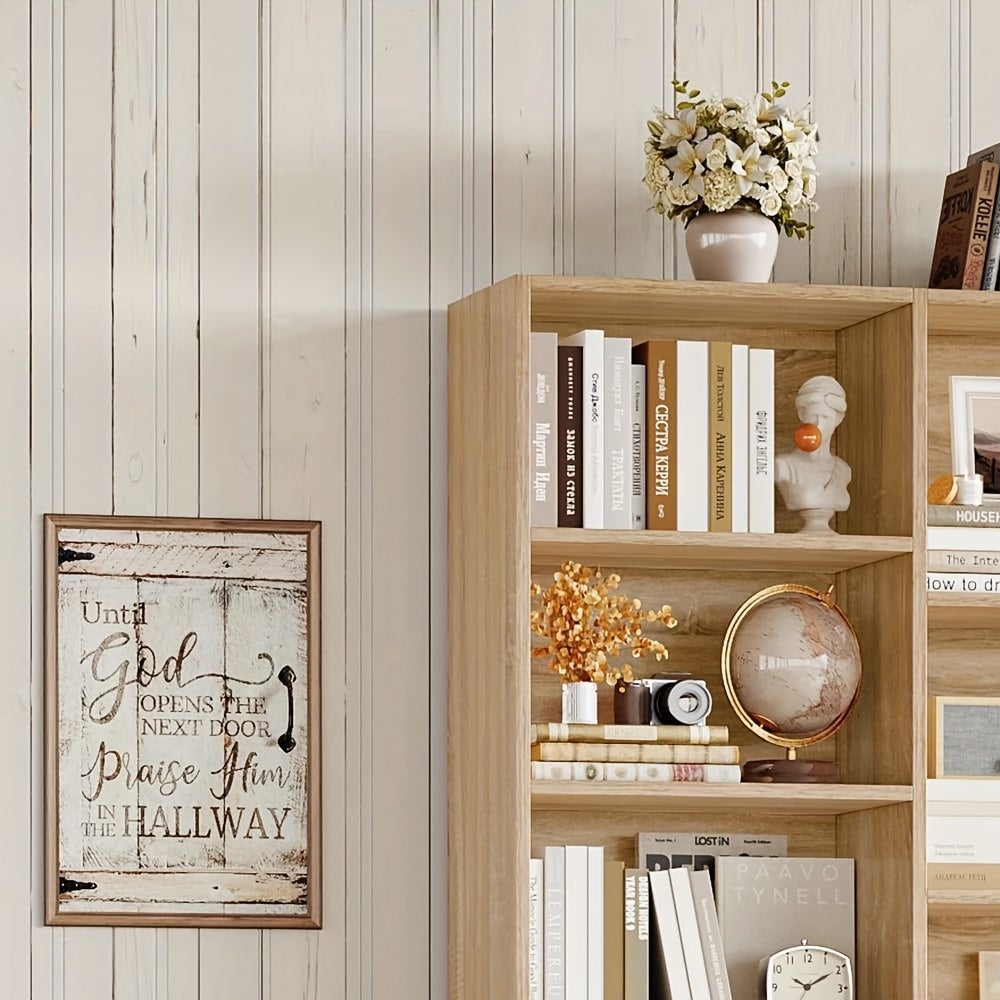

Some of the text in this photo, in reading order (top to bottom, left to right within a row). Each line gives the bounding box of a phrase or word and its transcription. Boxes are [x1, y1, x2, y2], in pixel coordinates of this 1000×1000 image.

[655, 404, 669, 453] СЕСТРА
[534, 423, 550, 467] Мартин
[611, 450, 624, 512] ТРАКТАТЫ
[655, 455, 669, 496] КЕРРИ
[534, 472, 550, 502] Иден
[946, 554, 966, 565] The
[962, 578, 977, 592] to
[81, 601, 148, 625] Until
[141, 695, 267, 714] OPENS THE
[141, 719, 272, 738] NEXT DOOR
[209, 741, 291, 800] Him
[97, 805, 115, 819] IN
[81, 805, 292, 840] THE HALLWAY
[694, 836, 716, 846] LOST
[736, 864, 839, 881] PAAVO
[625, 876, 635, 897] YEAR
[732, 887, 847, 905] TYNELL
[786, 956, 794, 965] 11
[803, 954, 813, 964] 12
[773, 964, 782, 974] 10
